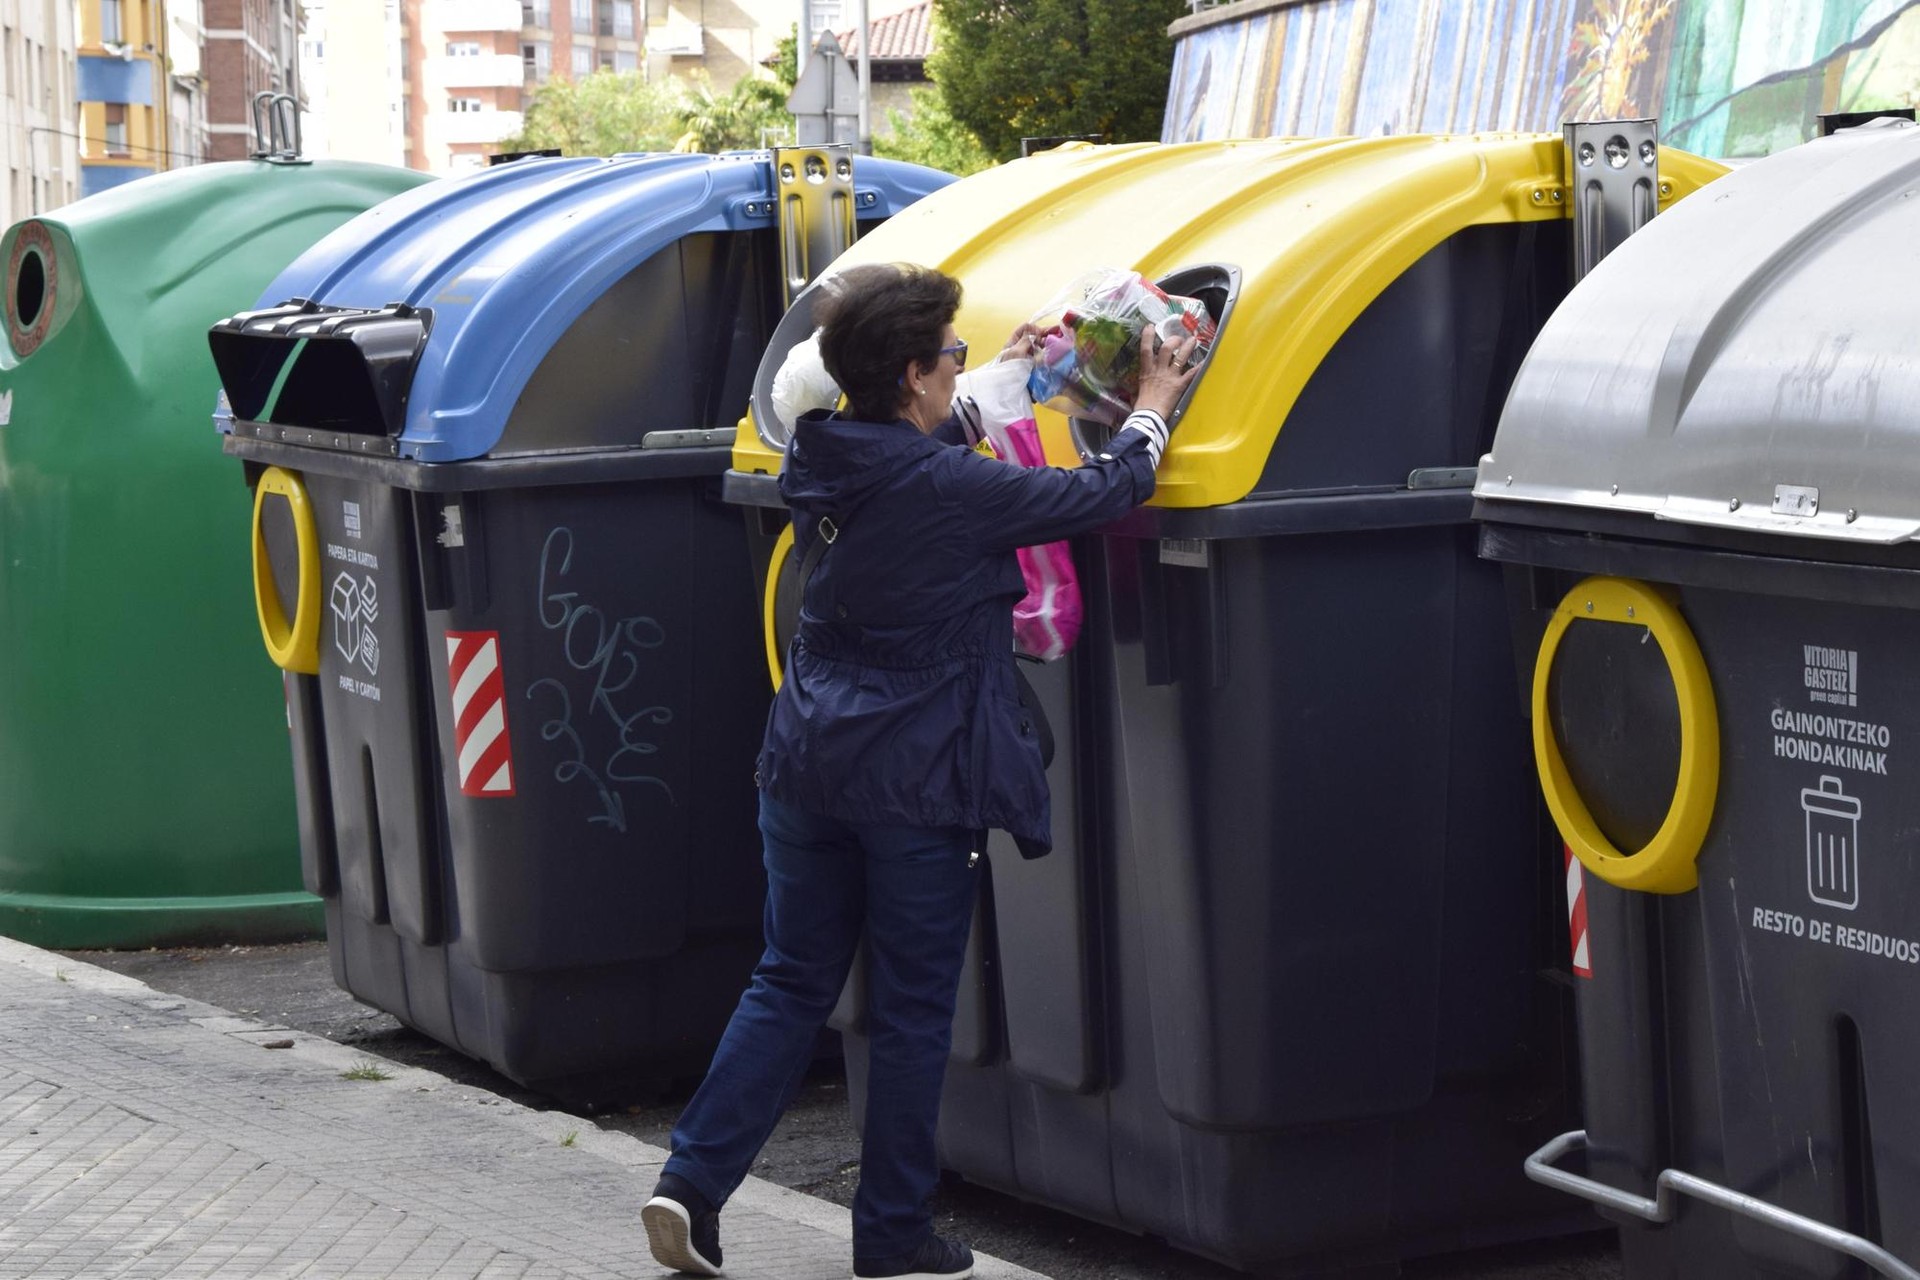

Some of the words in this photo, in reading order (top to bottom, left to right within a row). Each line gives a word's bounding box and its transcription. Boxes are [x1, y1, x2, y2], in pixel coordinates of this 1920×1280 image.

[347, 548, 358, 564] ETA
[1803, 645, 1848, 671] VITORIA
[339, 675, 355, 693] PAPEL
[354, 680, 360, 695] Y
[1804, 666, 1848, 692] GASTEIZ
[1770, 708, 1890, 748] GAINONTZEKO
[1774, 735, 1888, 775] HONDAKINAK
[1752, 906, 1804, 937] RESTO
[1809, 919, 1831, 943] DE
[1835, 924, 1920, 964] RESIDUOS
